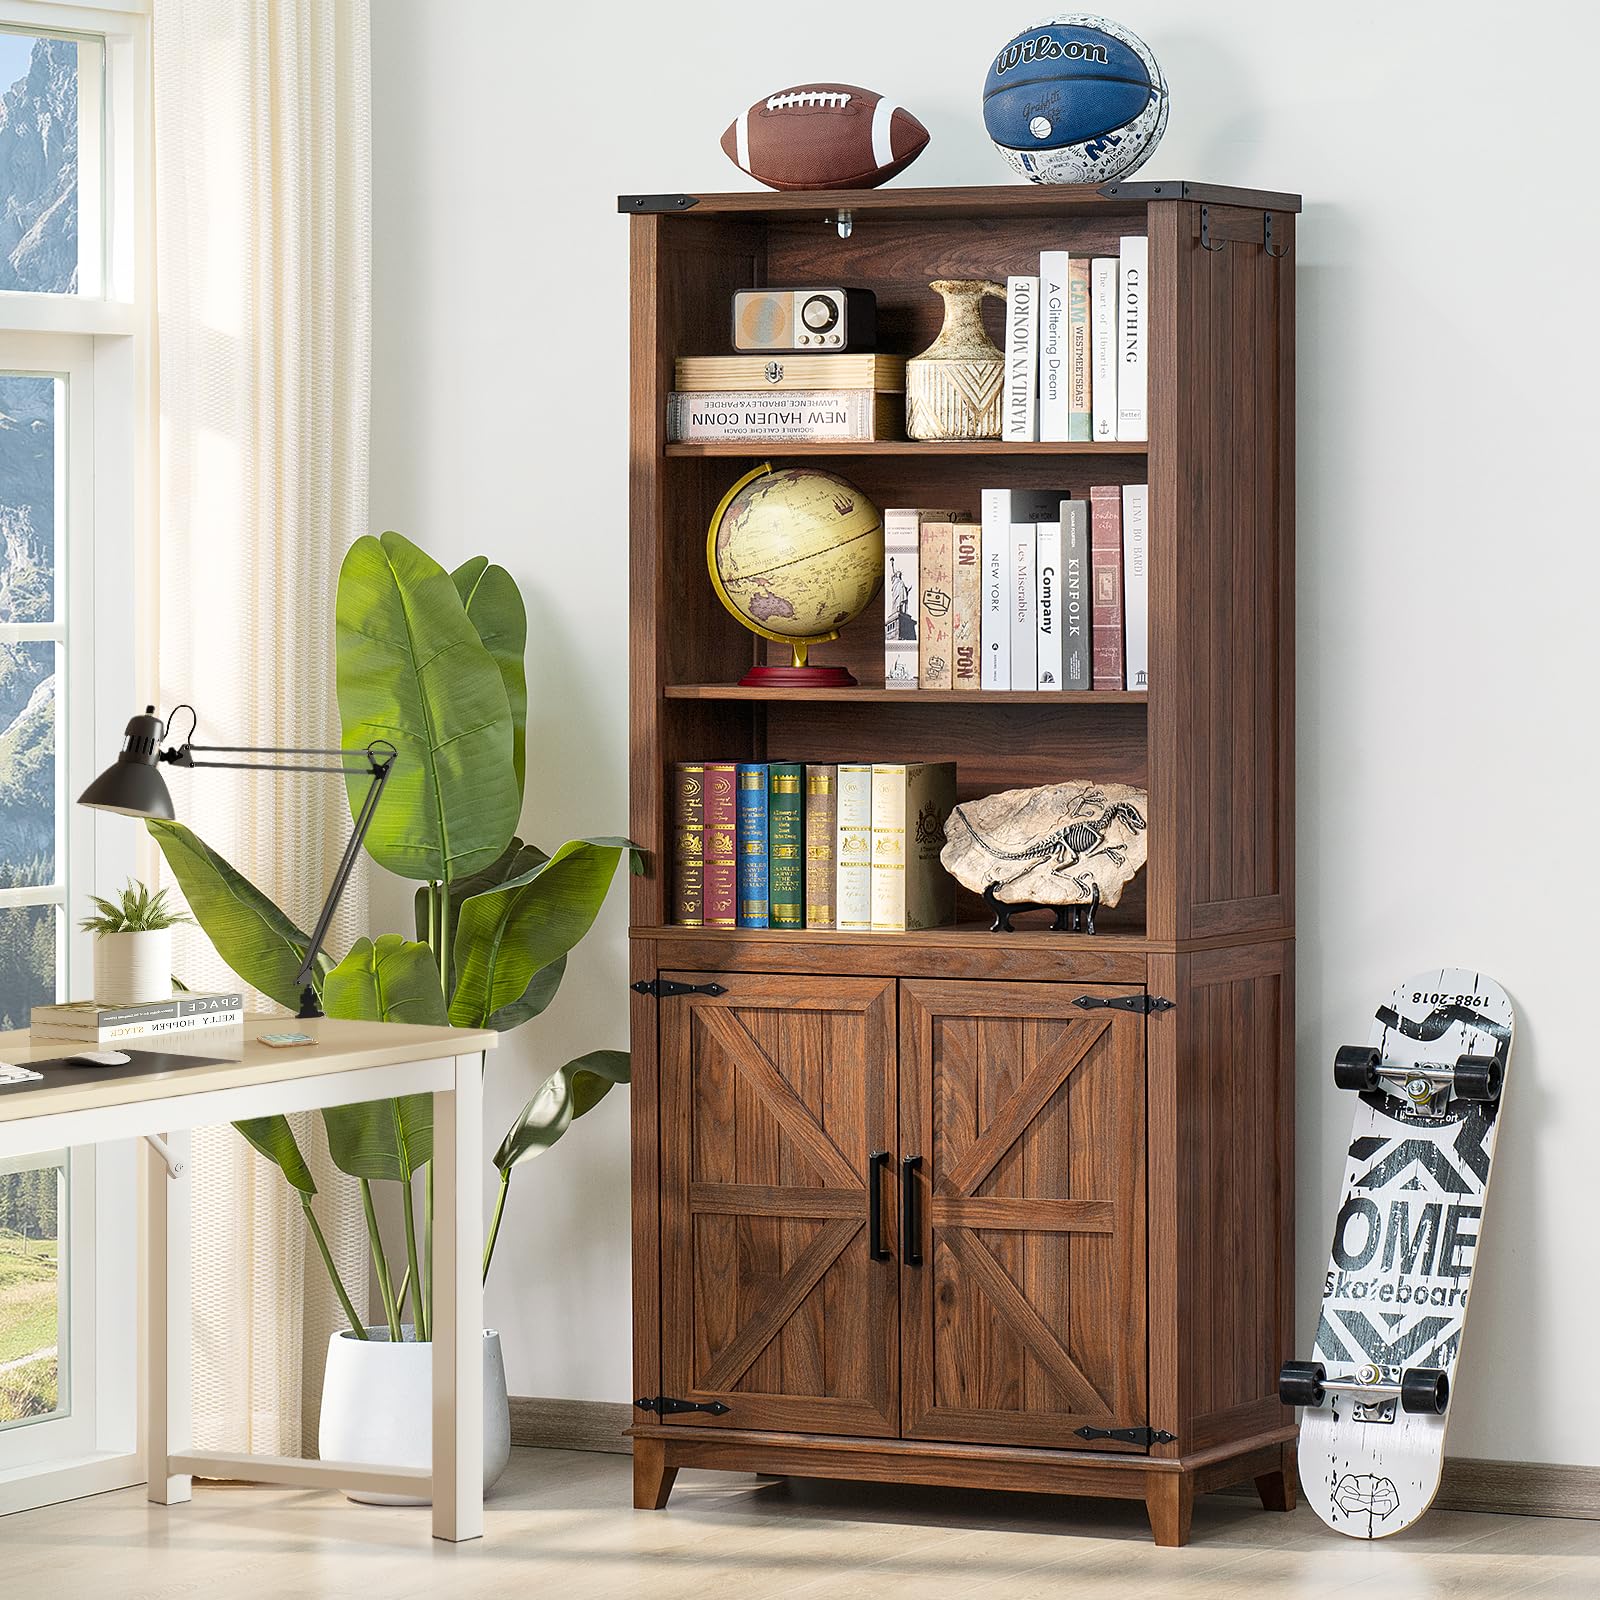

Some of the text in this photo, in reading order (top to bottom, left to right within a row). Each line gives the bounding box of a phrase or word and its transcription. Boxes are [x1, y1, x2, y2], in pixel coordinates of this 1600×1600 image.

[996, 35, 1108, 75] Wilson
[1070, 279, 1089, 324] CAM
[1100, 271, 1108, 288] The
[1046, 283, 1062, 401] A Glittering Dream
[1126, 269, 1139, 363] CLOTHING
[1010, 282, 1030, 434] MARILYN MONROE
[1100, 331, 1109, 379] libraries
[692, 412, 739, 426] CONN
[808, 411, 847, 425] NEW
[1121, 411, 1140, 419] Better
[1132, 498, 1143, 577] LINA BO BARDI
[991, 553, 999, 612] NEW YORK
[1018, 543, 1028, 623] Les Miserables
[1040, 567, 1055, 634] Company
[1068, 558, 1080, 637] KINFOLK
[1412, 992, 1489, 1008] 1988-2018
